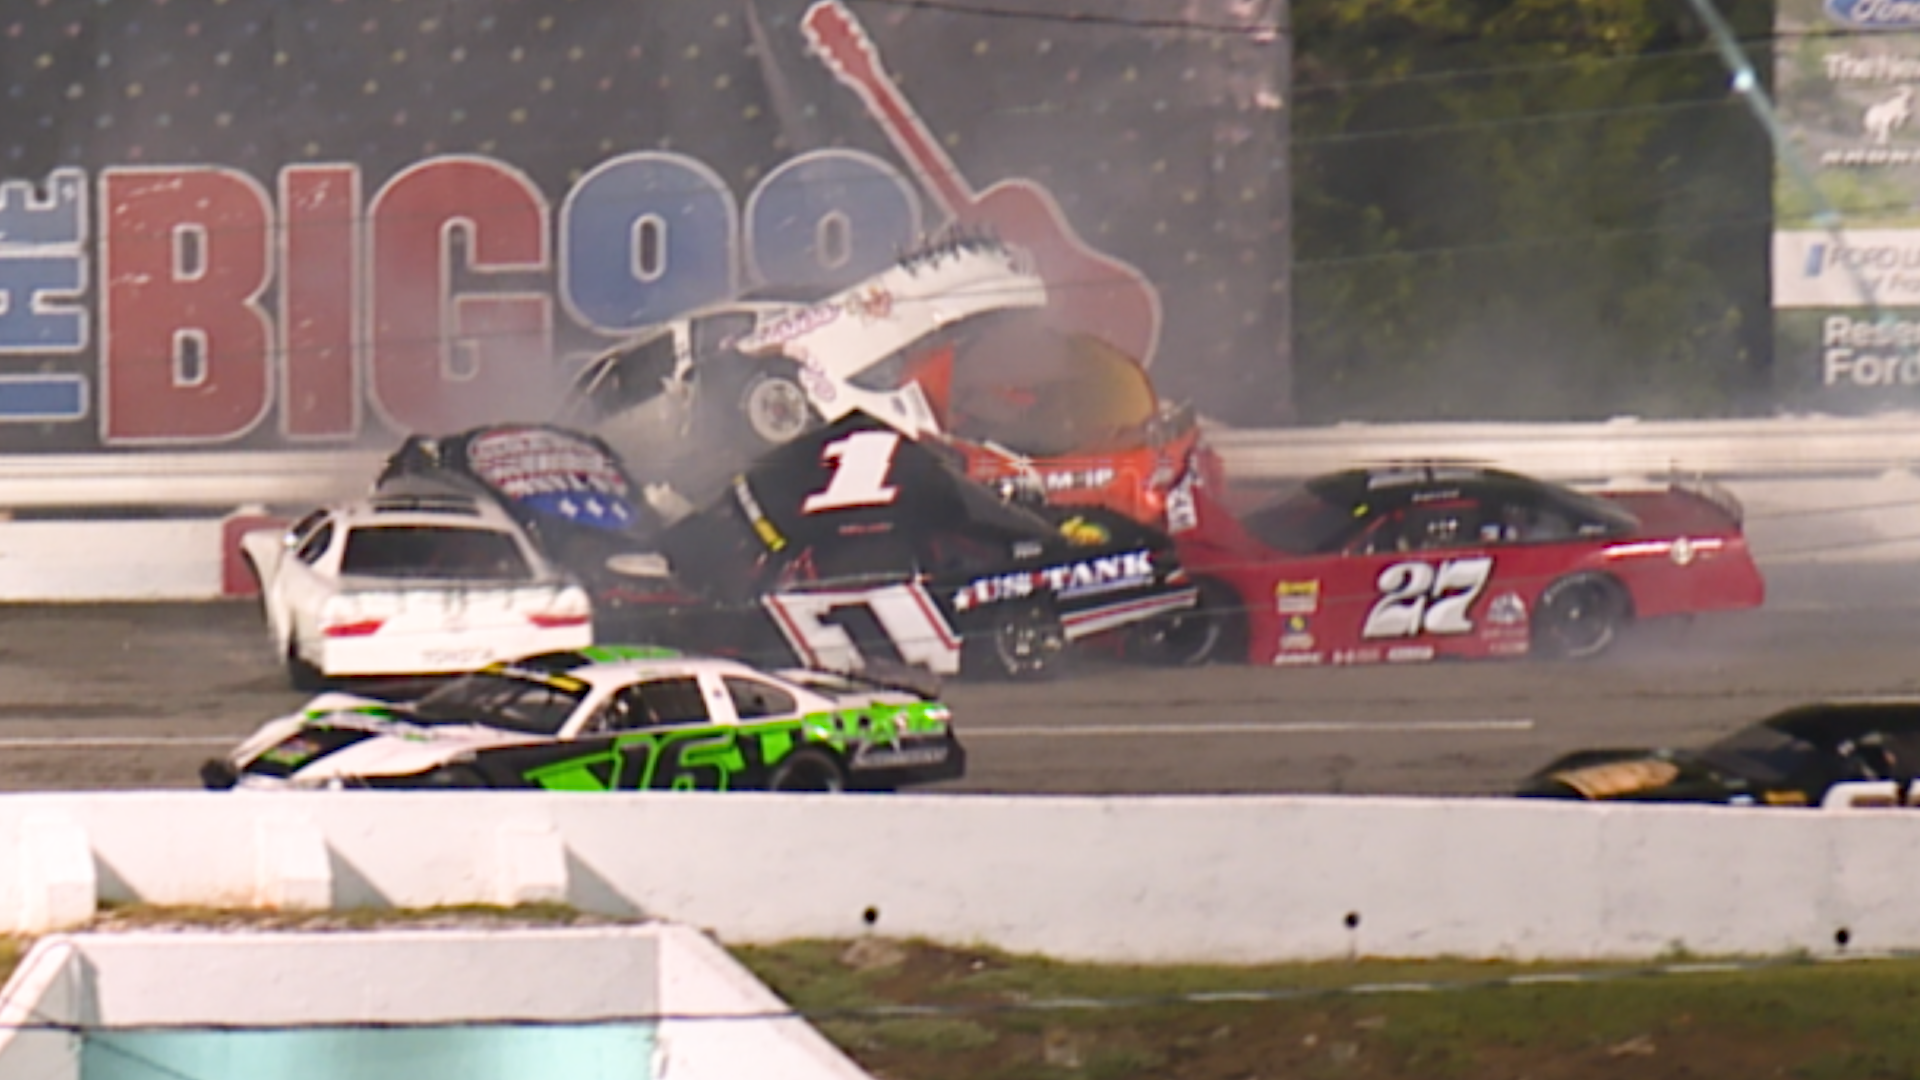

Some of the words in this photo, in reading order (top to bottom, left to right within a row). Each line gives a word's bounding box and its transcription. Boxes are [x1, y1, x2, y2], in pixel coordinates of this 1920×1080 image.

[99, 153, 553, 443] BIG
[801, 430, 901, 513] 1
[1046, 549, 1156, 592] TANK
[1361, 554, 1494, 639] 27
